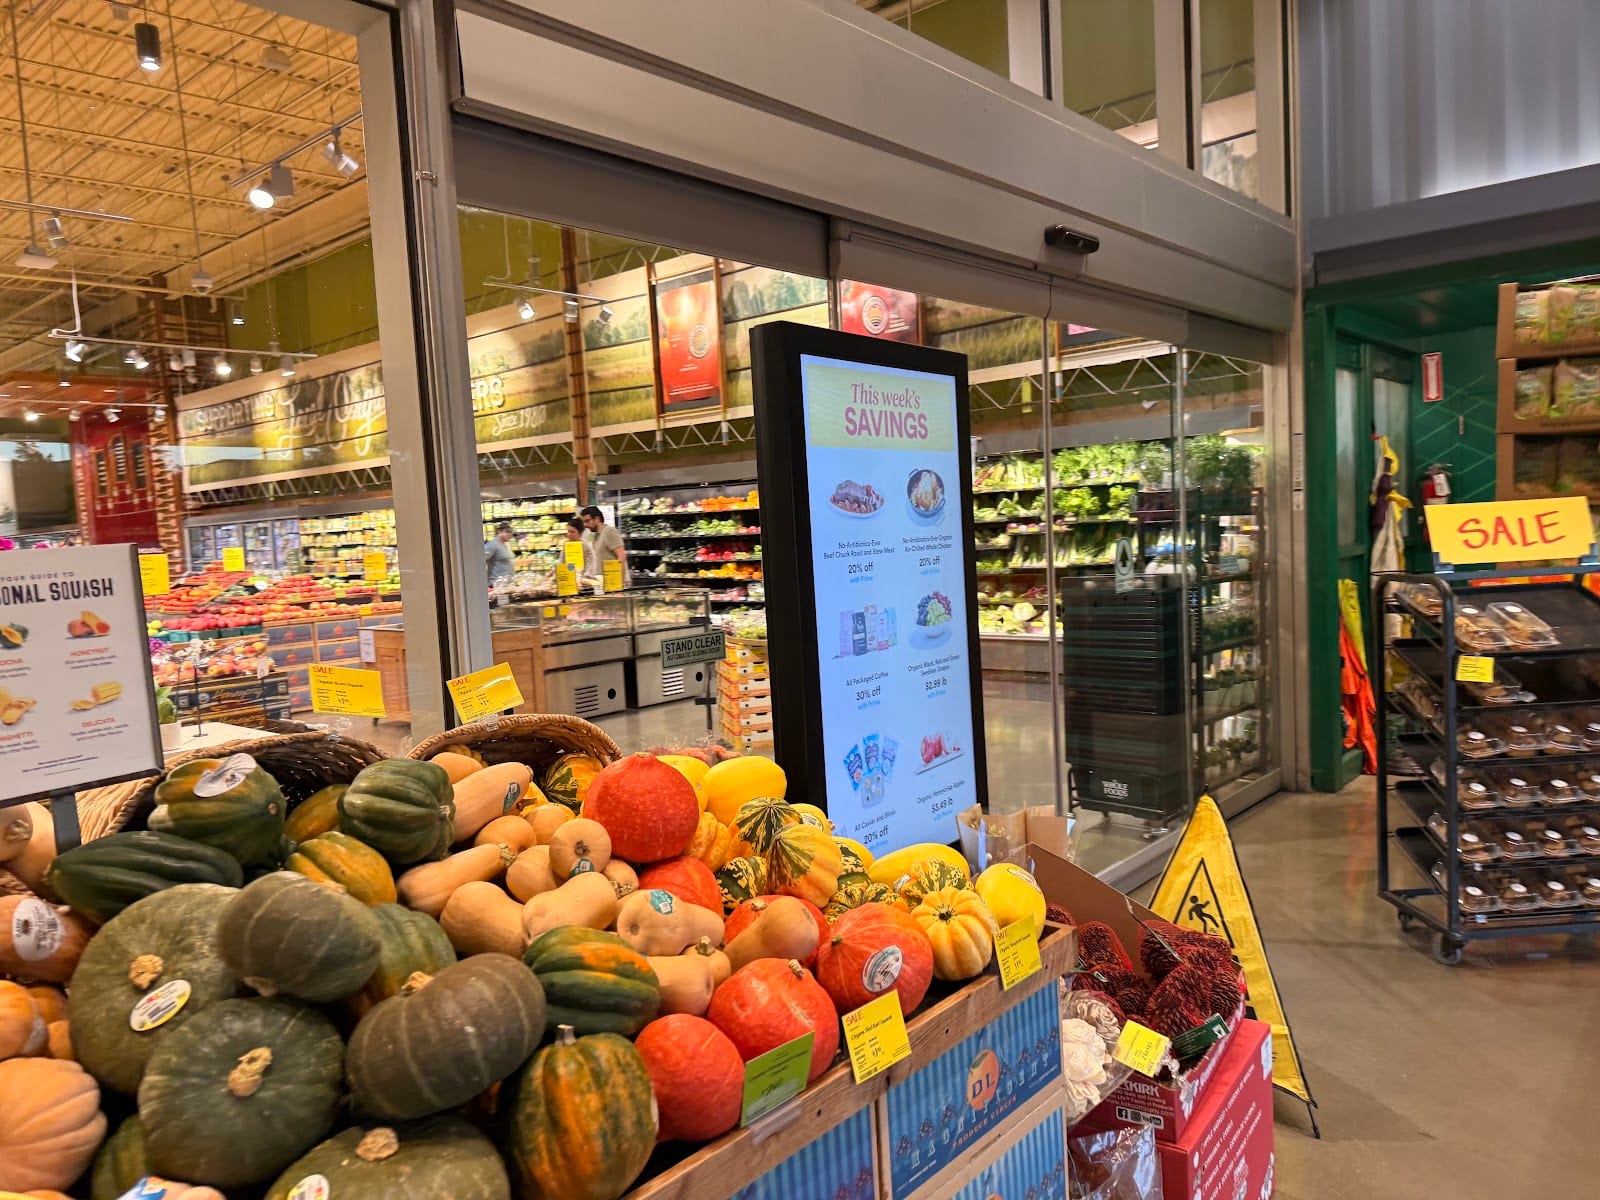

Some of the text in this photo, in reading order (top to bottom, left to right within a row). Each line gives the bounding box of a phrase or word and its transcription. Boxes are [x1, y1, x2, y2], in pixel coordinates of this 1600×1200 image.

[851, 383, 920, 409] This week's
[195, 391, 275, 431] SUPPORTING
[491, 406, 547, 437] Since 1980
[845, 406, 928, 440] SAVINGS
[1457, 510, 1566, 549] SALE
[838, 539, 881, 549] No-Antibiotics-Ever
[823, 552, 834, 560] Beef
[835, 551, 850, 559] Chuck
[919, 555, 940, 567] 20% off
[848, 561, 874, 574] 20% off
[30, 572, 59, 580] GUIDE
[0, 577, 114, 606] ONAL SQUASH
[665, 635, 721, 654] STAND CLEAR
[667, 651, 691, 661] AUTOMATIC
[312, 665, 335, 675] SALE
[907, 663, 923, 672] Organic
[451, 677, 470, 687] SALE
[853, 675, 874, 684] Packaged
[875, 671, 889, 680] Coffee
[942, 676, 947, 686] lb
[856, 685, 881, 701] 30% off
[1104, 787, 1129, 797] FOODS
[948, 796, 953, 807] lb
[861, 818, 876, 829] Caviar
[876, 813, 884, 823] and
[863, 825, 889, 844] 20% off
[845, 1010, 864, 1027] SALE
[952, 1118, 989, 1149] PRODUCE
